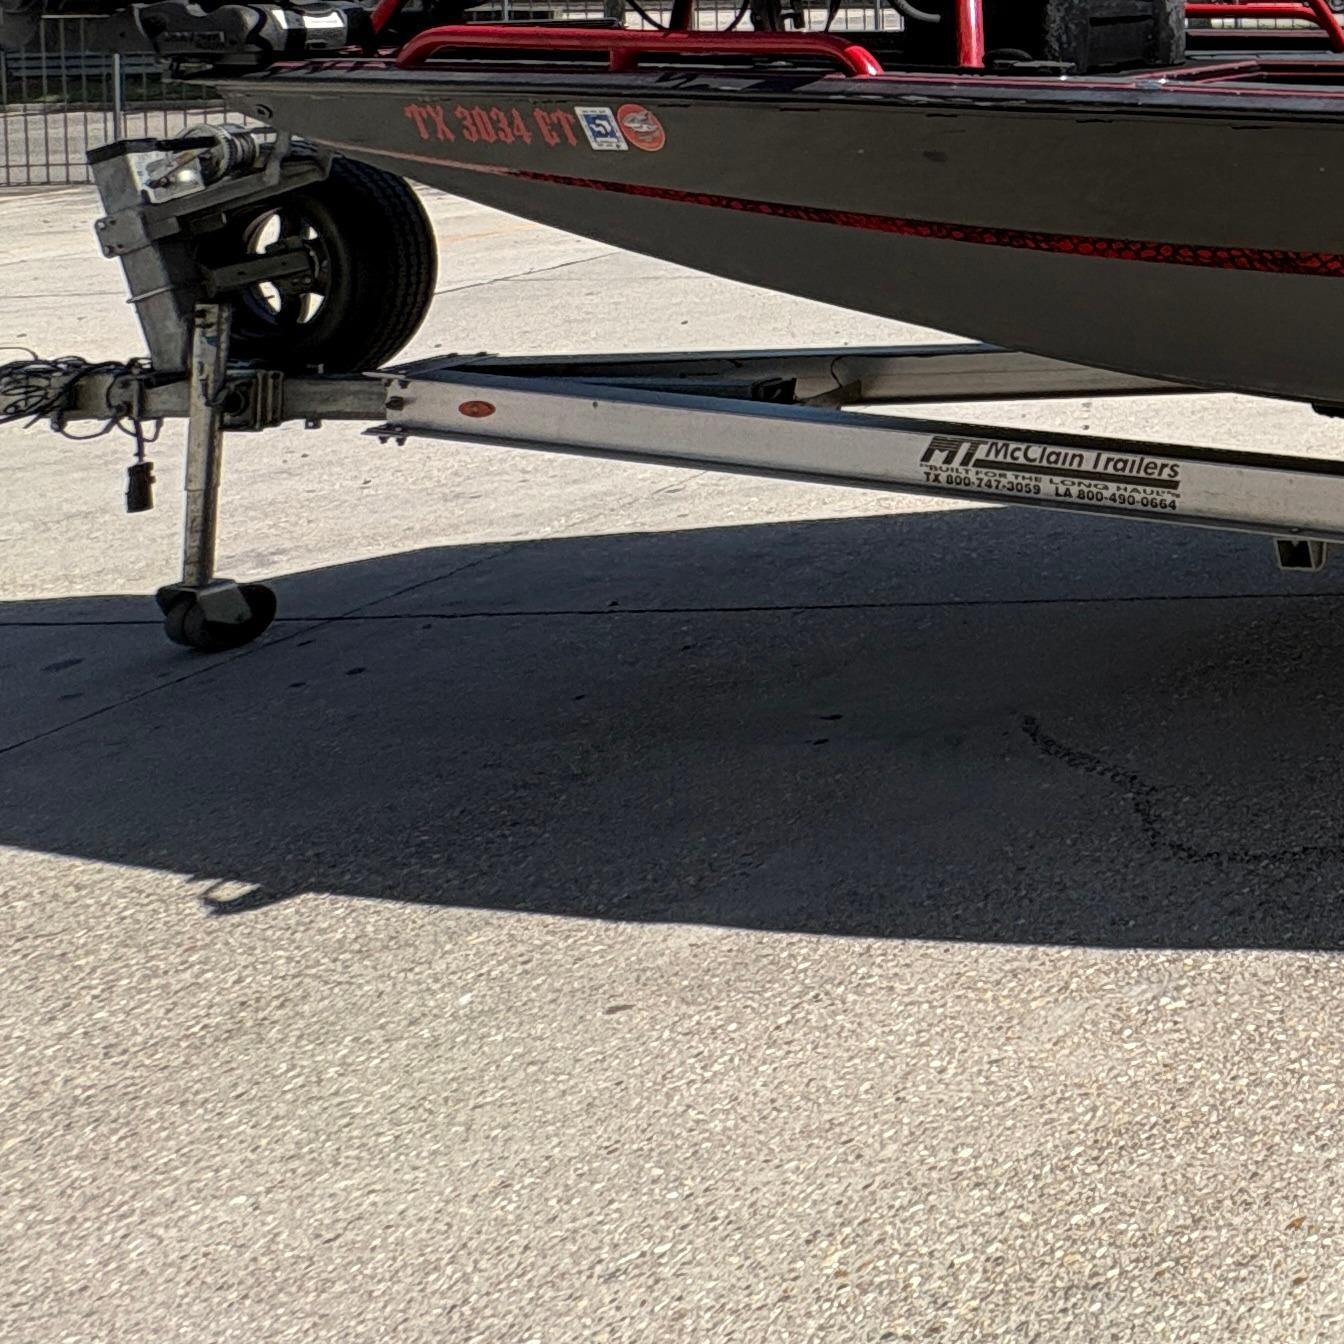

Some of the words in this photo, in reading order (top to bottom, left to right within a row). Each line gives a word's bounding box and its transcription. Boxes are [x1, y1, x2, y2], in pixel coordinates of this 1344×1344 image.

[404, 103, 457, 143] TX
[454, 105, 532, 145] 3034
[984, 442, 1085, 469] McClain
[1092, 452, 1181, 479] Trailers
[923, 472, 943, 484] TX
[1054, 486, 1074, 499] LA
[1013, 474, 1042, 484] THE
